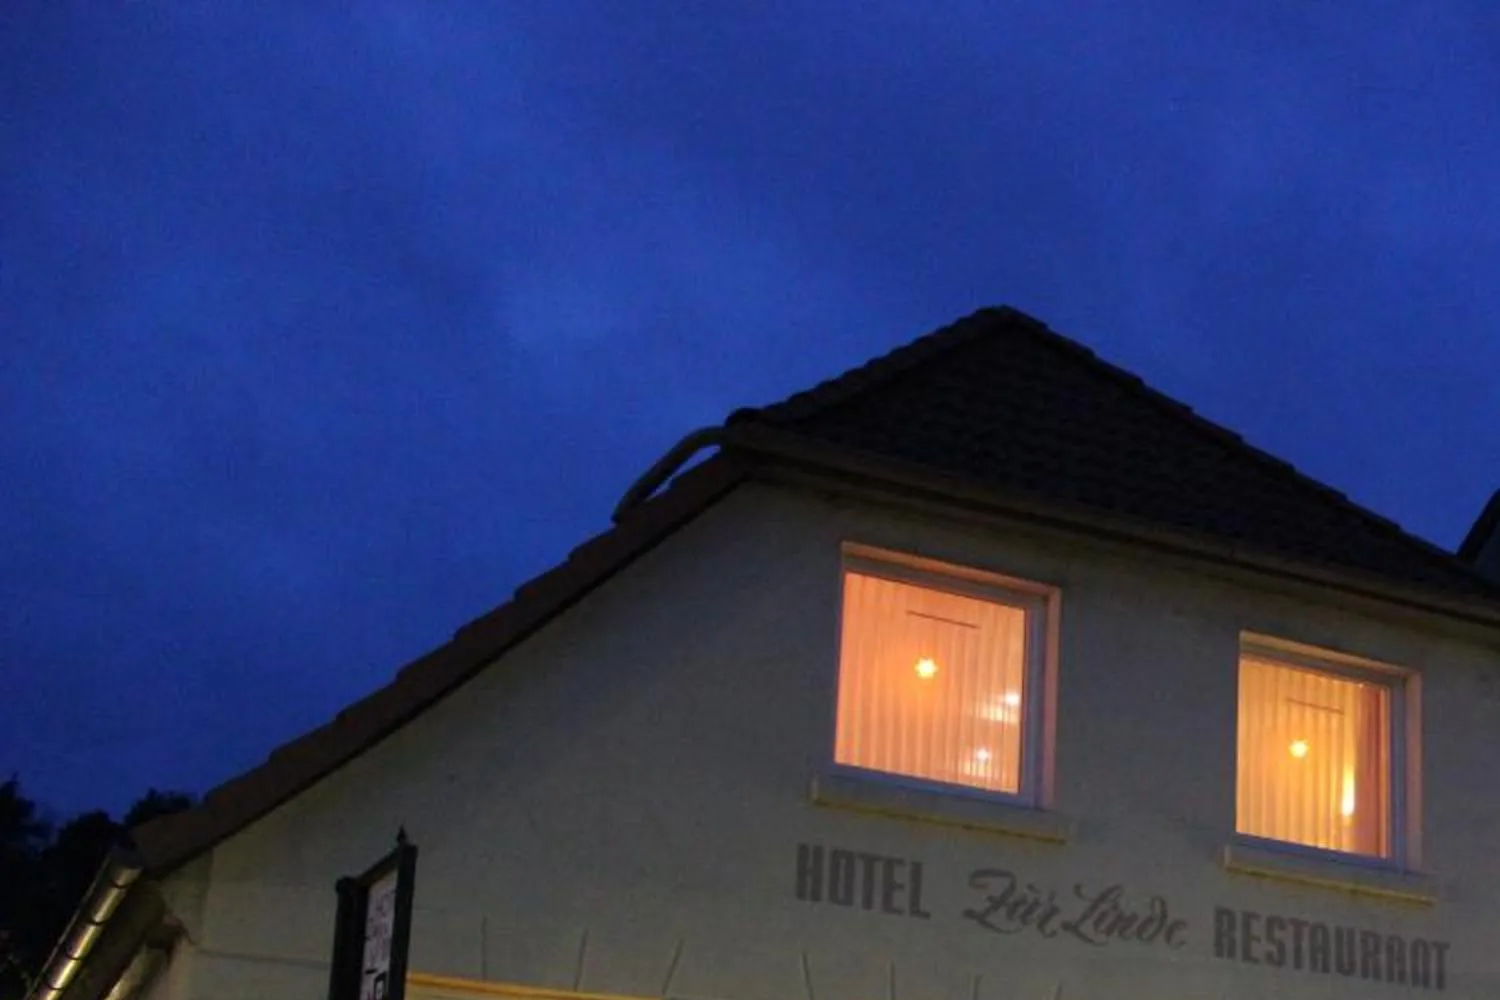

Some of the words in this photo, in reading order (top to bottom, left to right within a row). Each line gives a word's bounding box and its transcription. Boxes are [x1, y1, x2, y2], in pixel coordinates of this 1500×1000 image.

[796, 842, 931, 921] HOTEL
[1061, 883, 1187, 949] Linde
[1213, 904, 1451, 990] RESTAURANT
